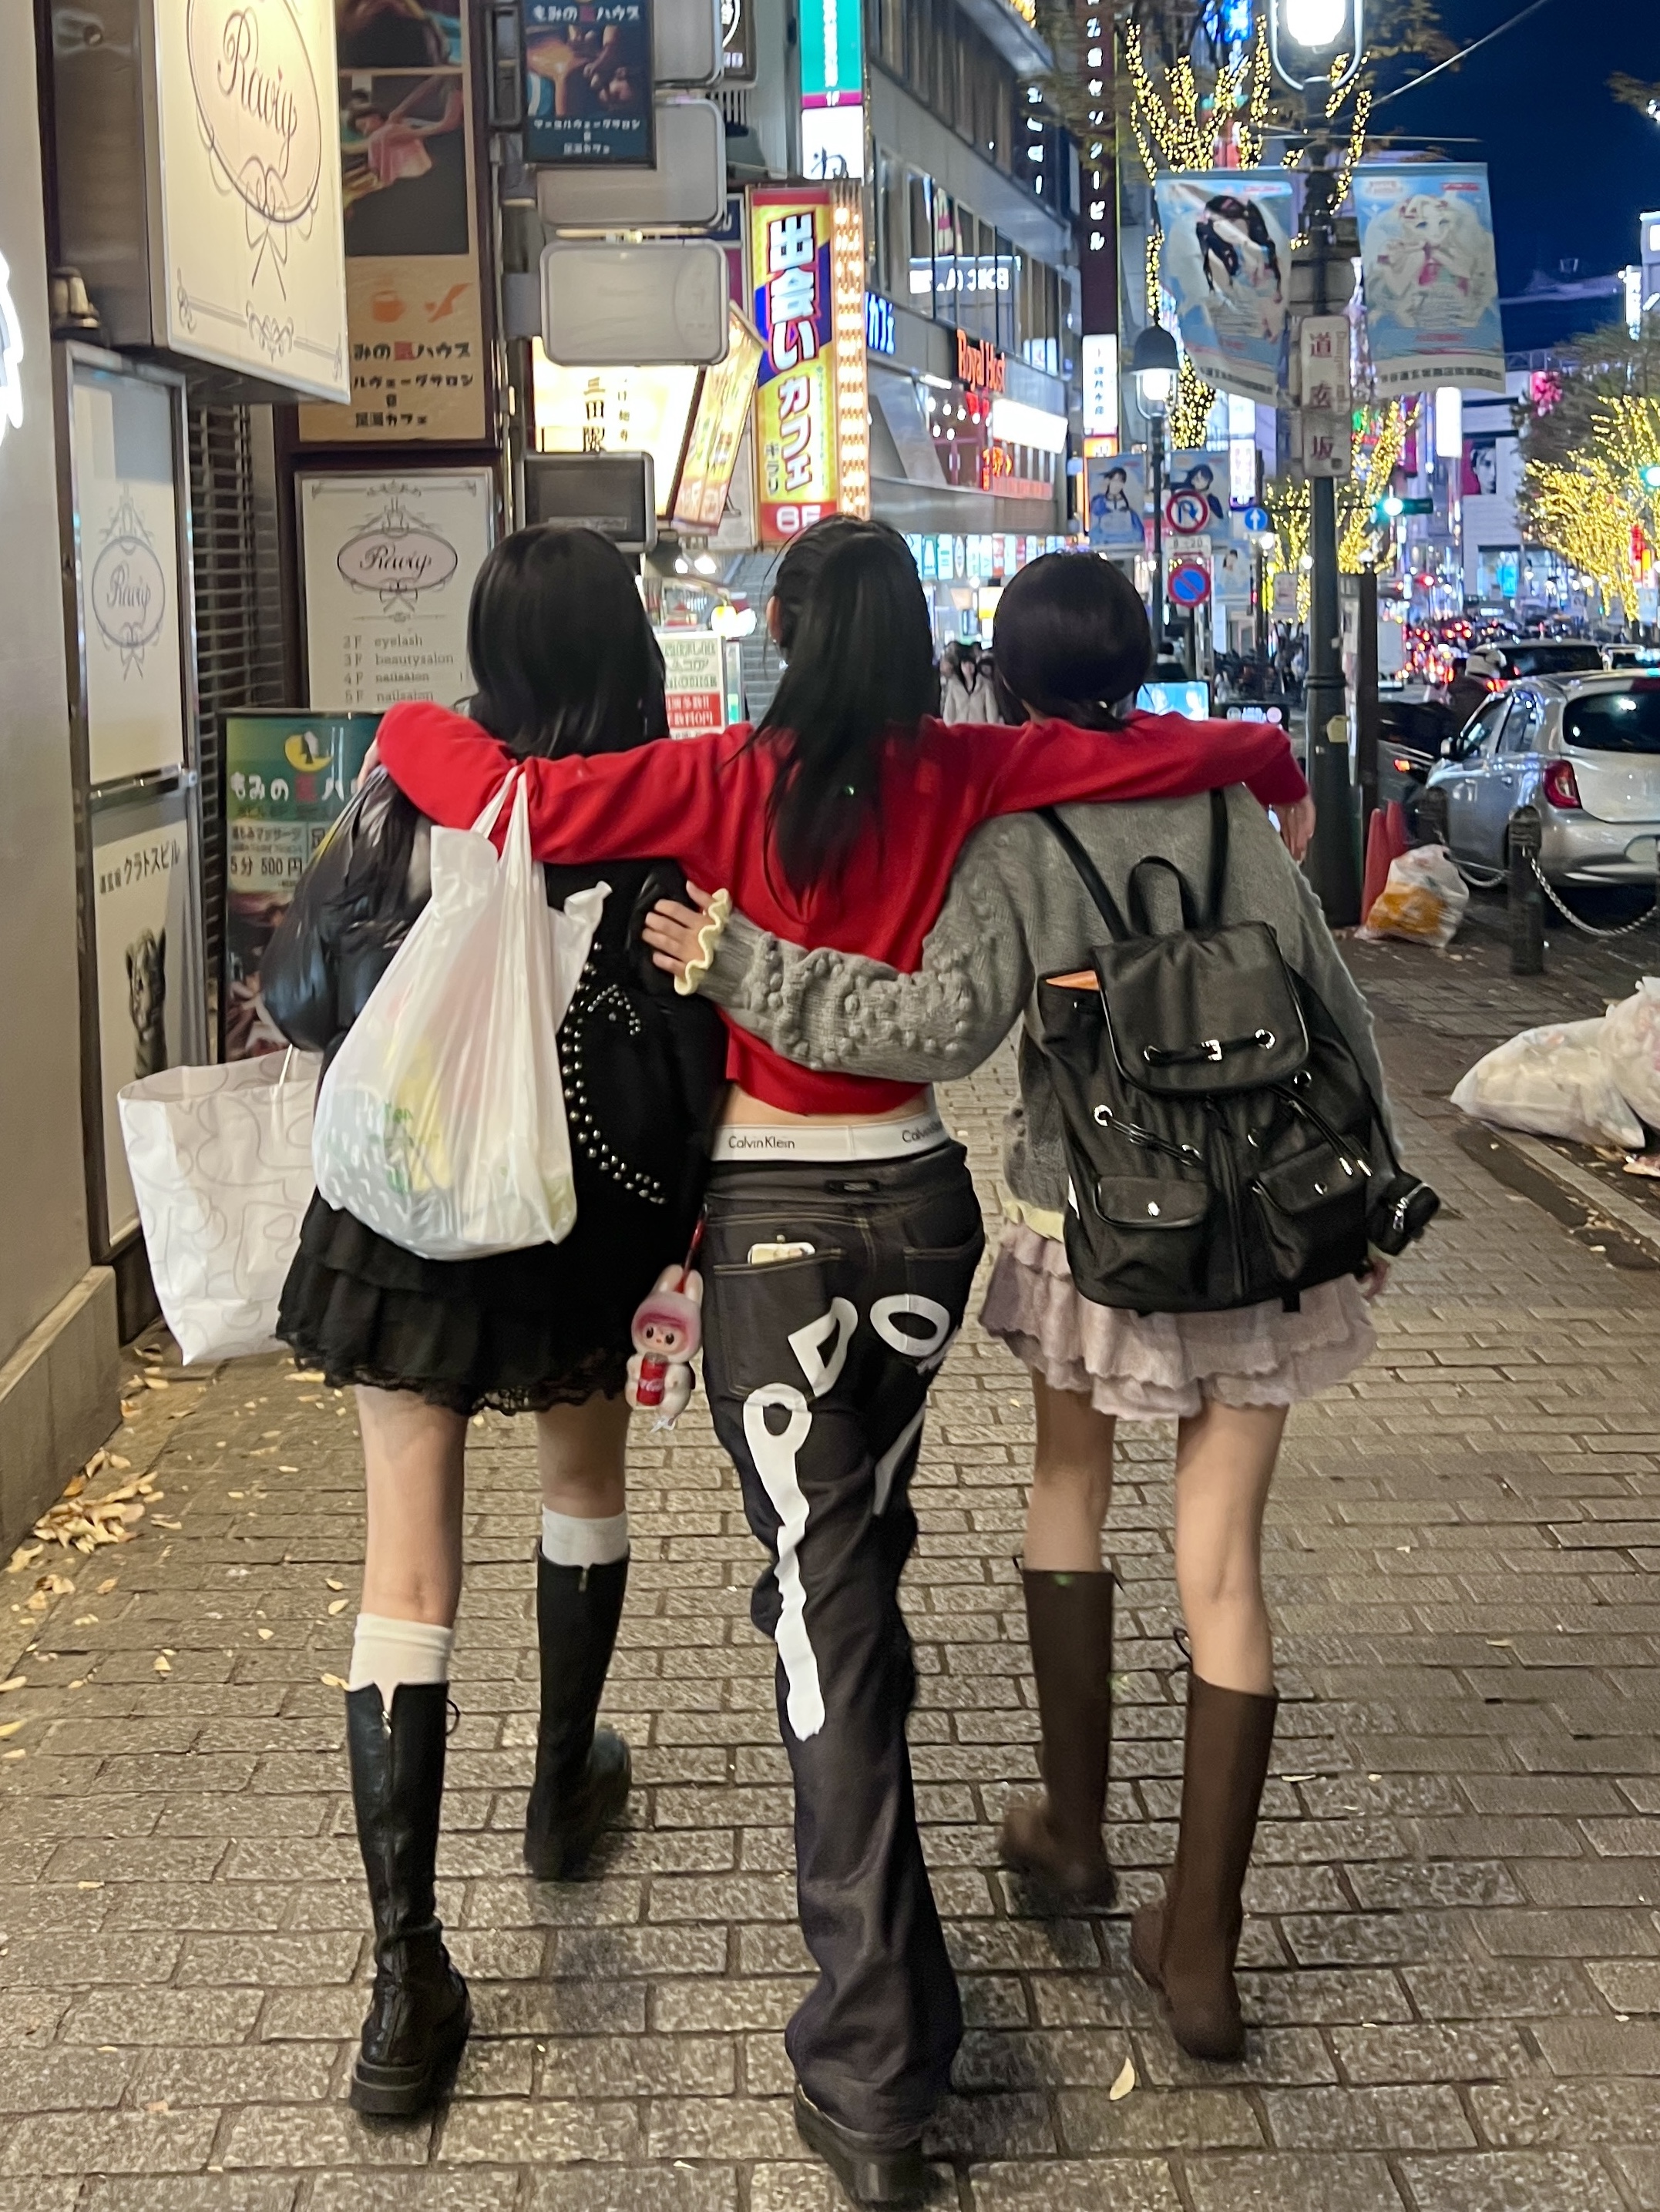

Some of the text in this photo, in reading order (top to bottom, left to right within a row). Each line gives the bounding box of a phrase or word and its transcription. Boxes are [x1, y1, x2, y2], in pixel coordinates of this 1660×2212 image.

[956, 328, 1006, 392] Royal Host
[375, 633, 423, 648] eyelash
